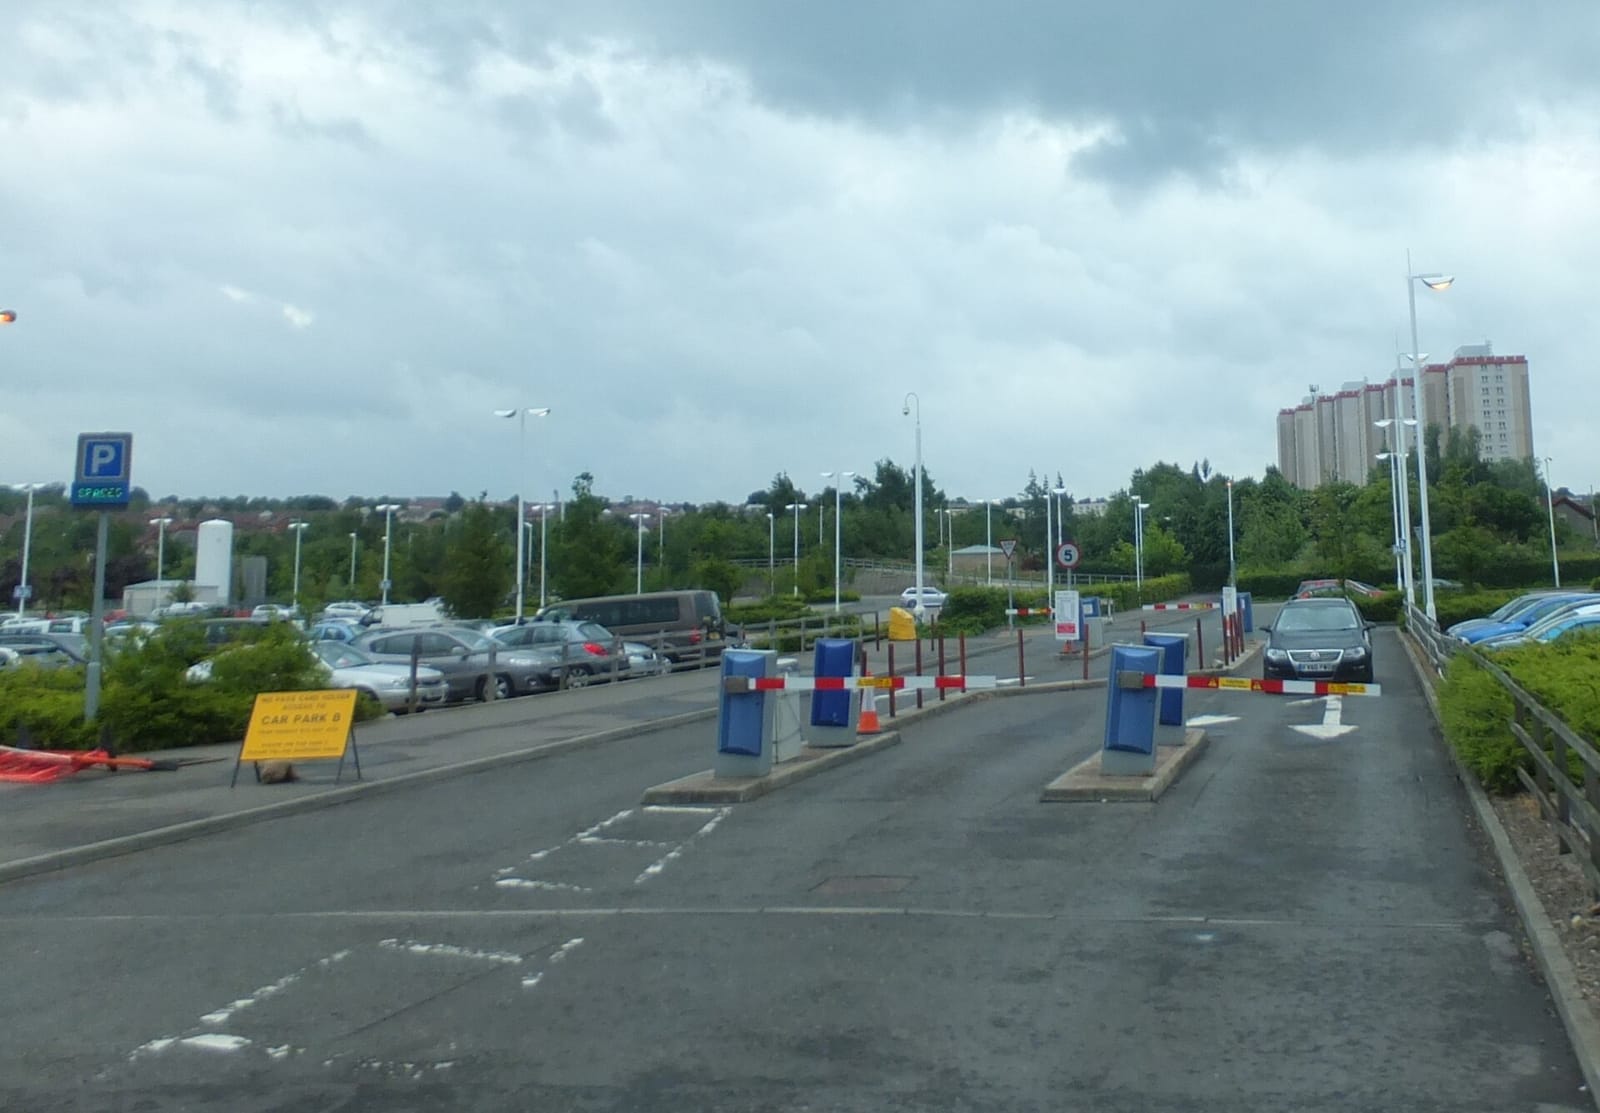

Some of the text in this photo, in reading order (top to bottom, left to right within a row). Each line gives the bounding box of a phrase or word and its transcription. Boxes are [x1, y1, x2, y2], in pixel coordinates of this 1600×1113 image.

[91, 444, 116, 475] P
[78, 487, 123, 498] SPACES
[1063, 549, 1073, 561] 5
[261, 712, 341, 725] CAR PARK B
